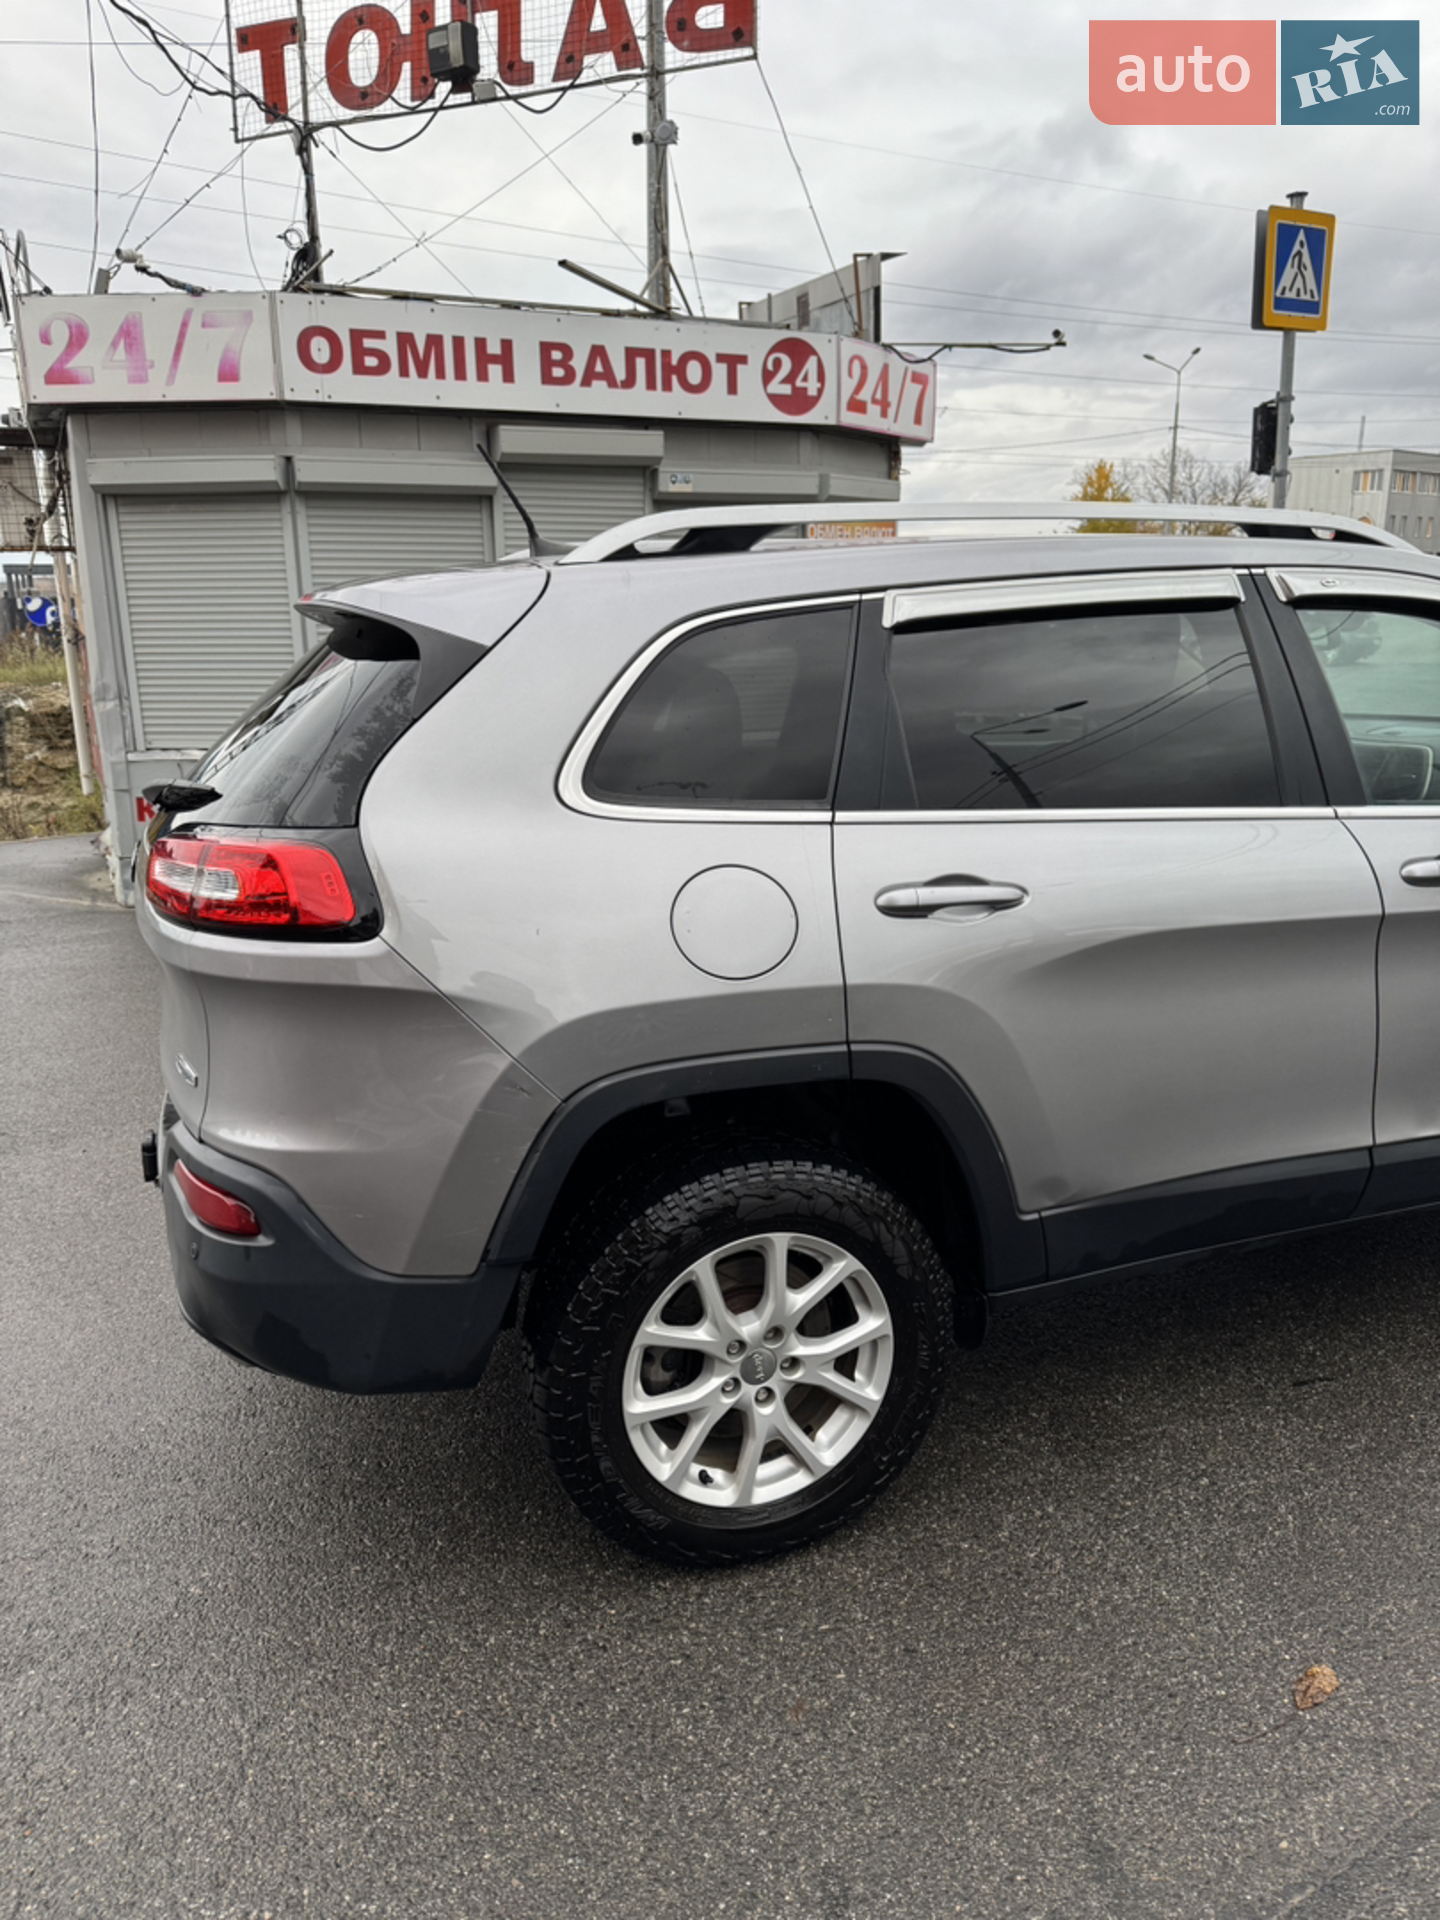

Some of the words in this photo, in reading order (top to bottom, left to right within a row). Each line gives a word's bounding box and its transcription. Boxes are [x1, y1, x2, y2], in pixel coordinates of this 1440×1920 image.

[38, 308, 254, 387] 24/7
[296, 325, 515, 384] ОБМІН
[539, 341, 748, 396] ВАЛЮТ
[766, 351, 821, 397] 24
[846, 353, 930, 427] 24/7
